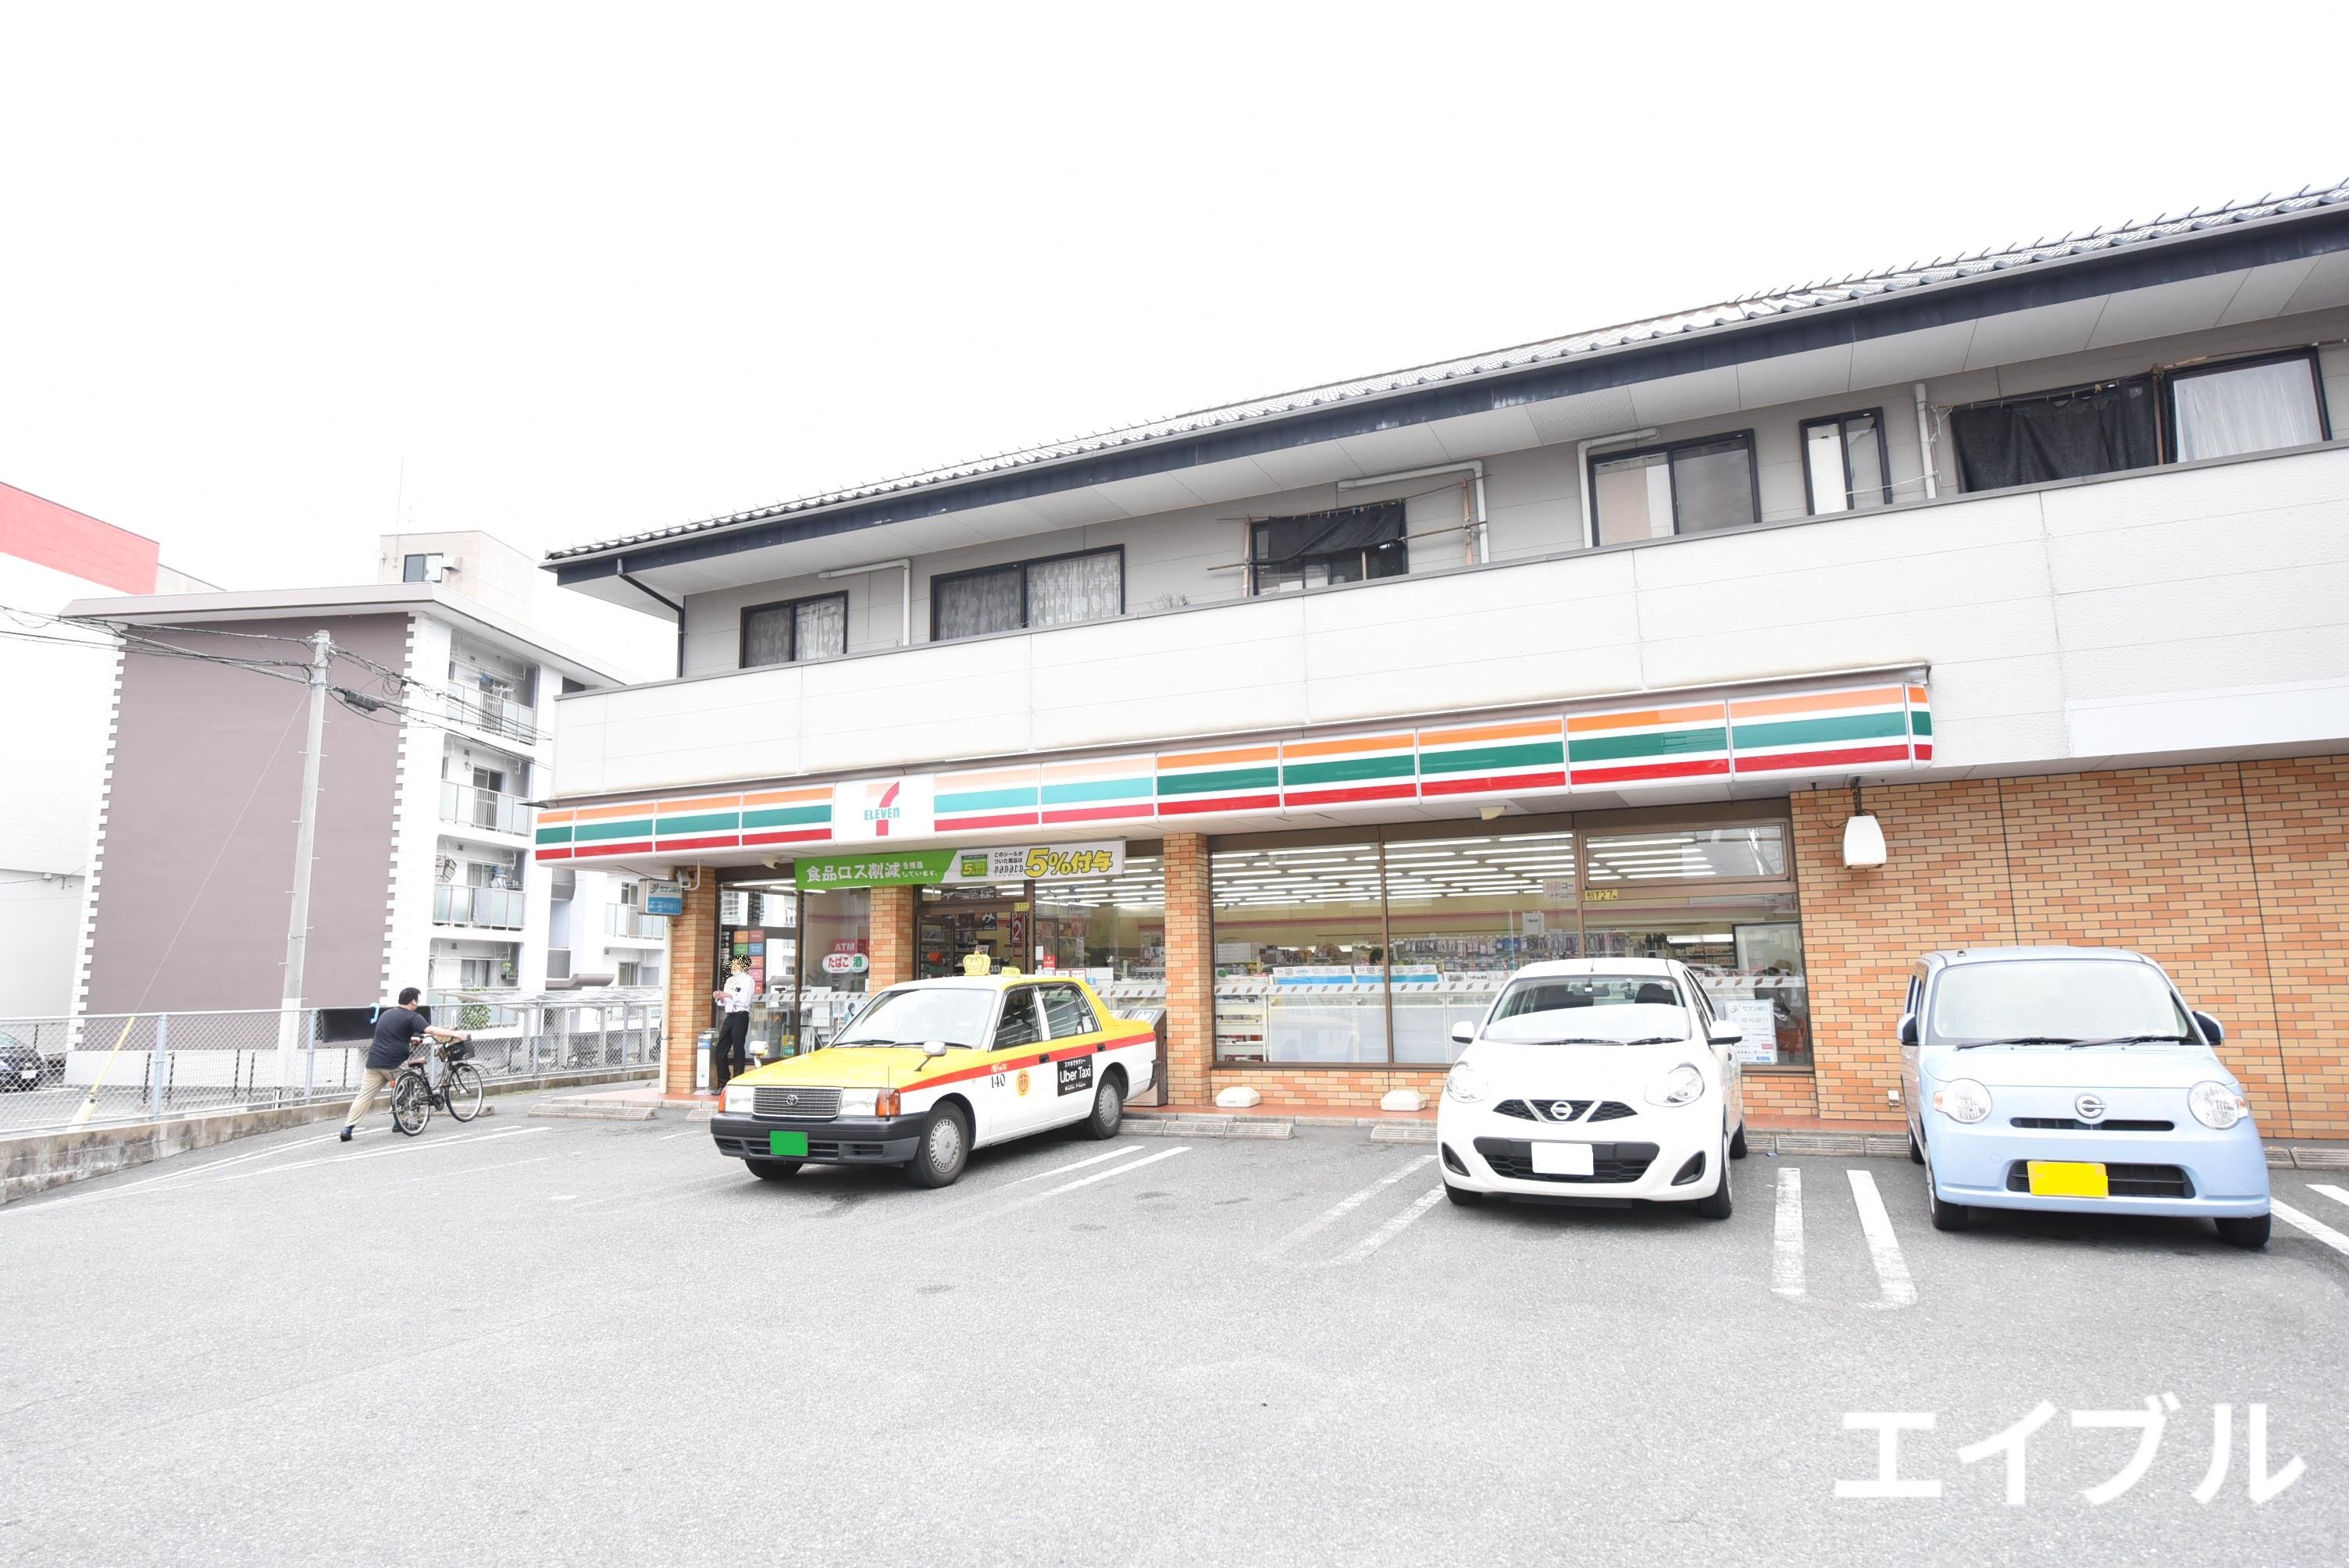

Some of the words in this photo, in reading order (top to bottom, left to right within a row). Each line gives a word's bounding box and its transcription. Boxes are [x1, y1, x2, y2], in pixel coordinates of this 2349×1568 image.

[994, 864, 1024, 874] nanaco
[1025, 847, 1113, 878] 5%付与
[807, 863, 900, 882] 食品ロス削減
[835, 943, 855, 951] ATM
[829, 956, 849, 968] たばこ
[853, 956, 863, 968] 酒
[1060, 1070, 1078, 1083] Uber
[1078, 1064, 1091, 1078] Taxi
[991, 1074, 1006, 1089] 140
